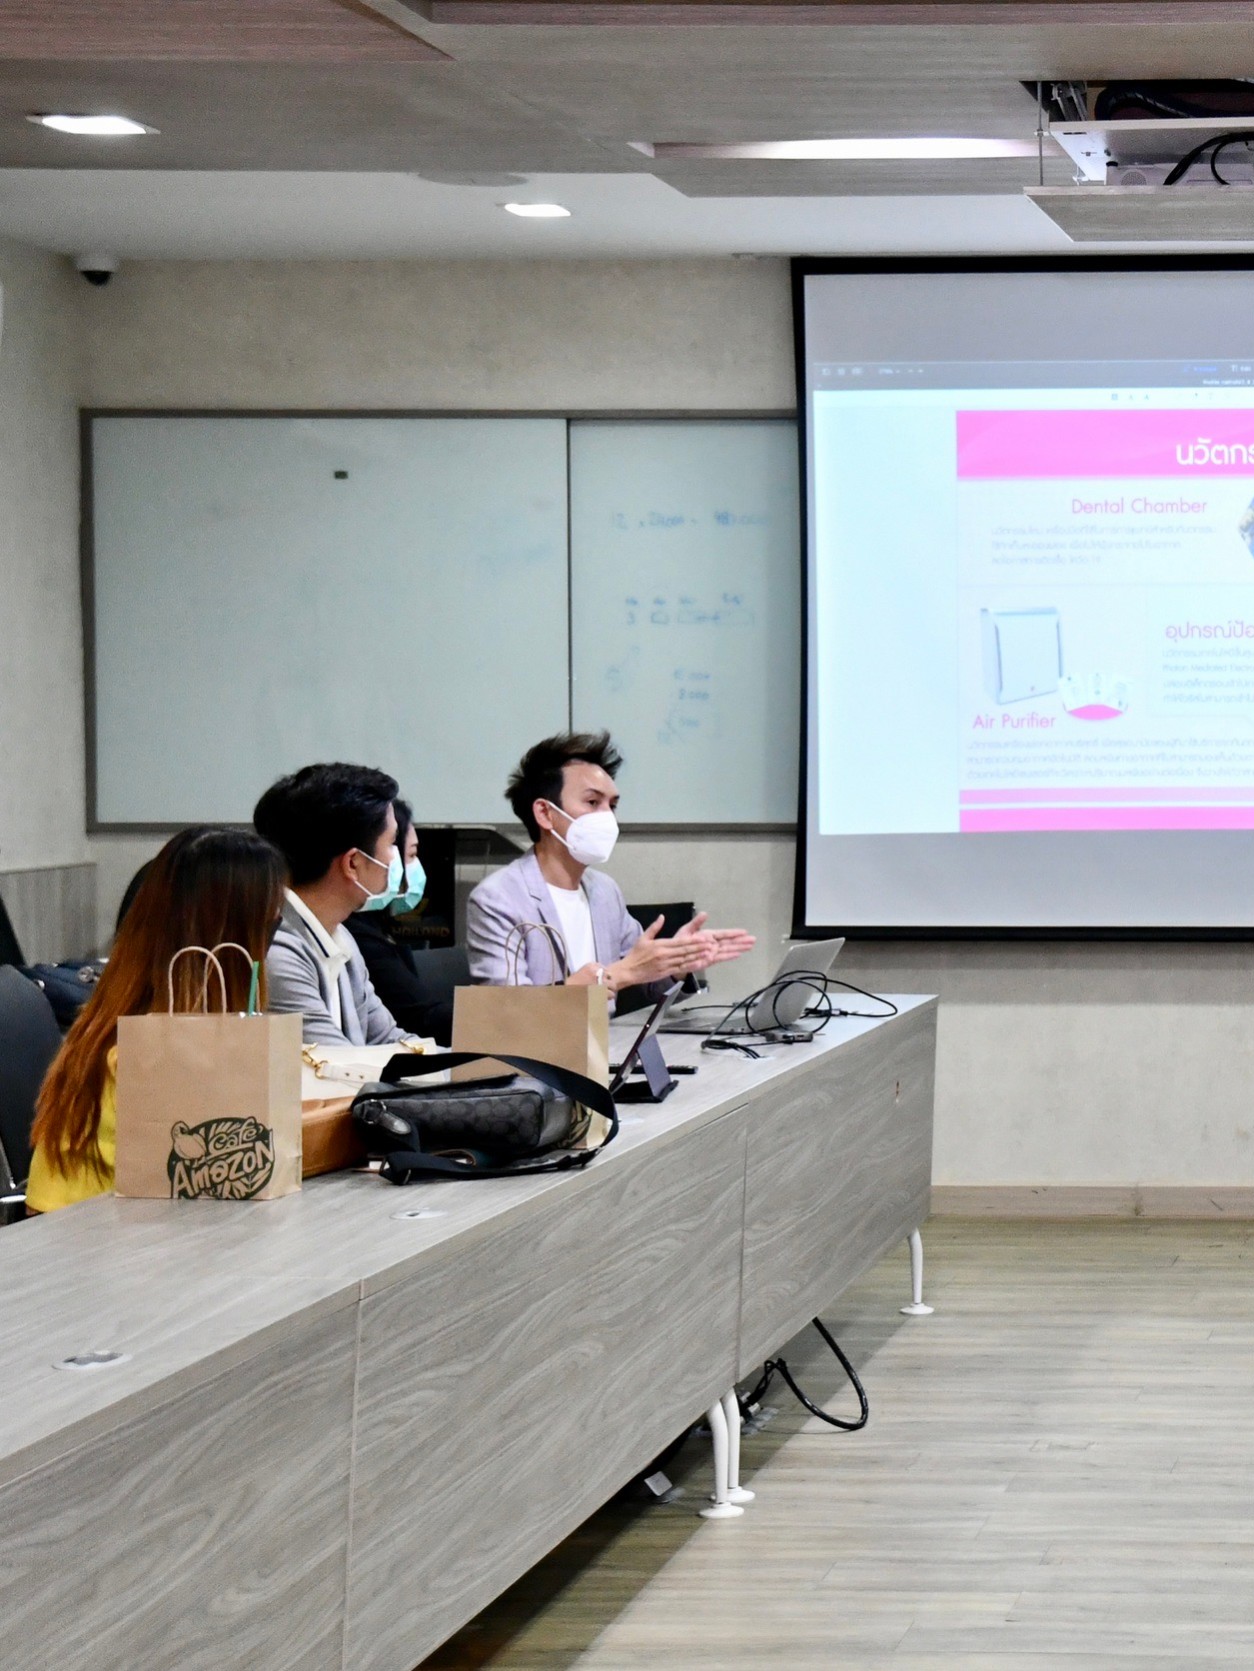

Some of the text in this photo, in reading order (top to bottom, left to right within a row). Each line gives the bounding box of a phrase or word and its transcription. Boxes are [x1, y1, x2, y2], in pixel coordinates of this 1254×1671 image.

[1071, 497, 1208, 514] Dental Chamber
[972, 711, 1056, 729] Air Purifier
